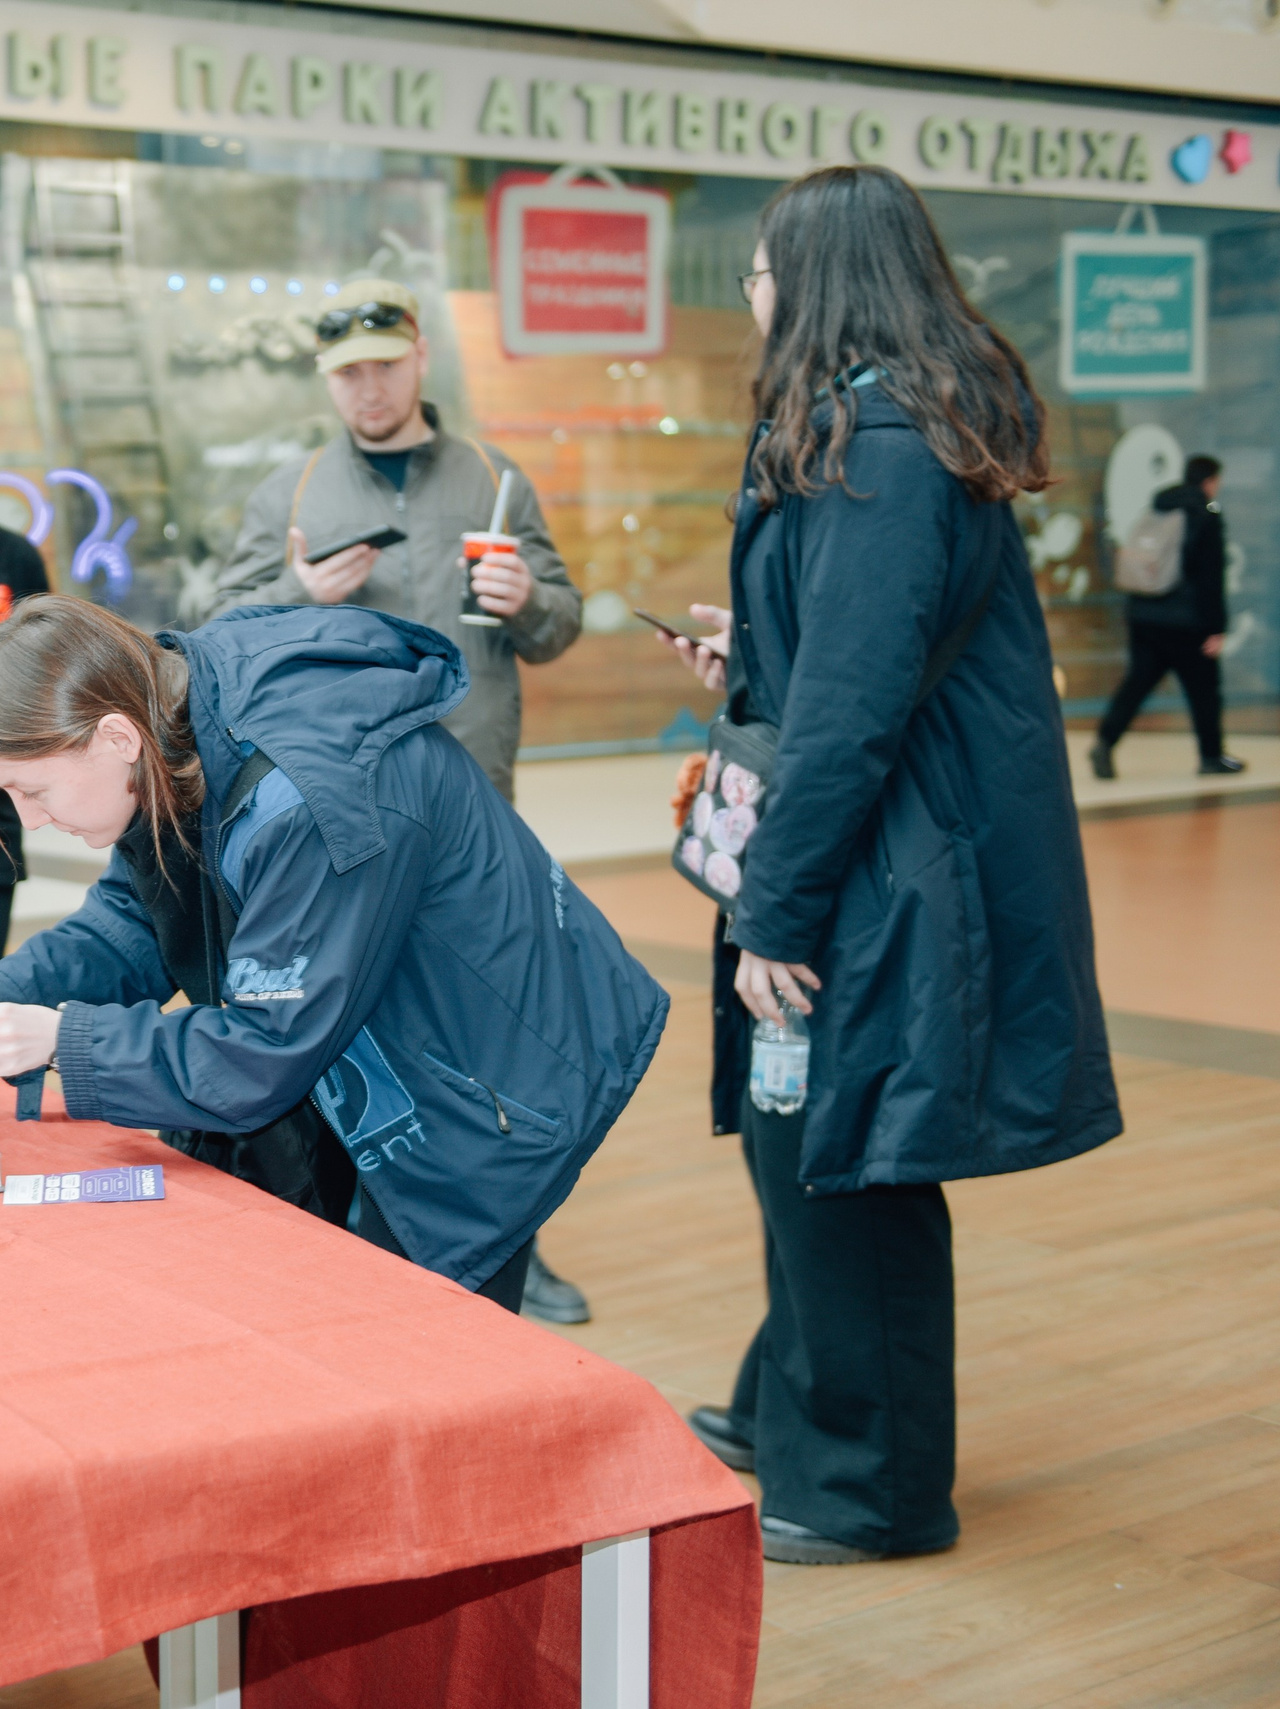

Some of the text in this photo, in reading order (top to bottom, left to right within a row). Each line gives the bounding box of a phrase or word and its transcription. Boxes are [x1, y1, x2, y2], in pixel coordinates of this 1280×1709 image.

[175, 44, 443, 131] ПАРКИ
[479, 78, 889, 164] АКТИВНОГО
[921, 115, 1152, 185] ОТДЫХА
[227, 955, 310, 993] Bud
